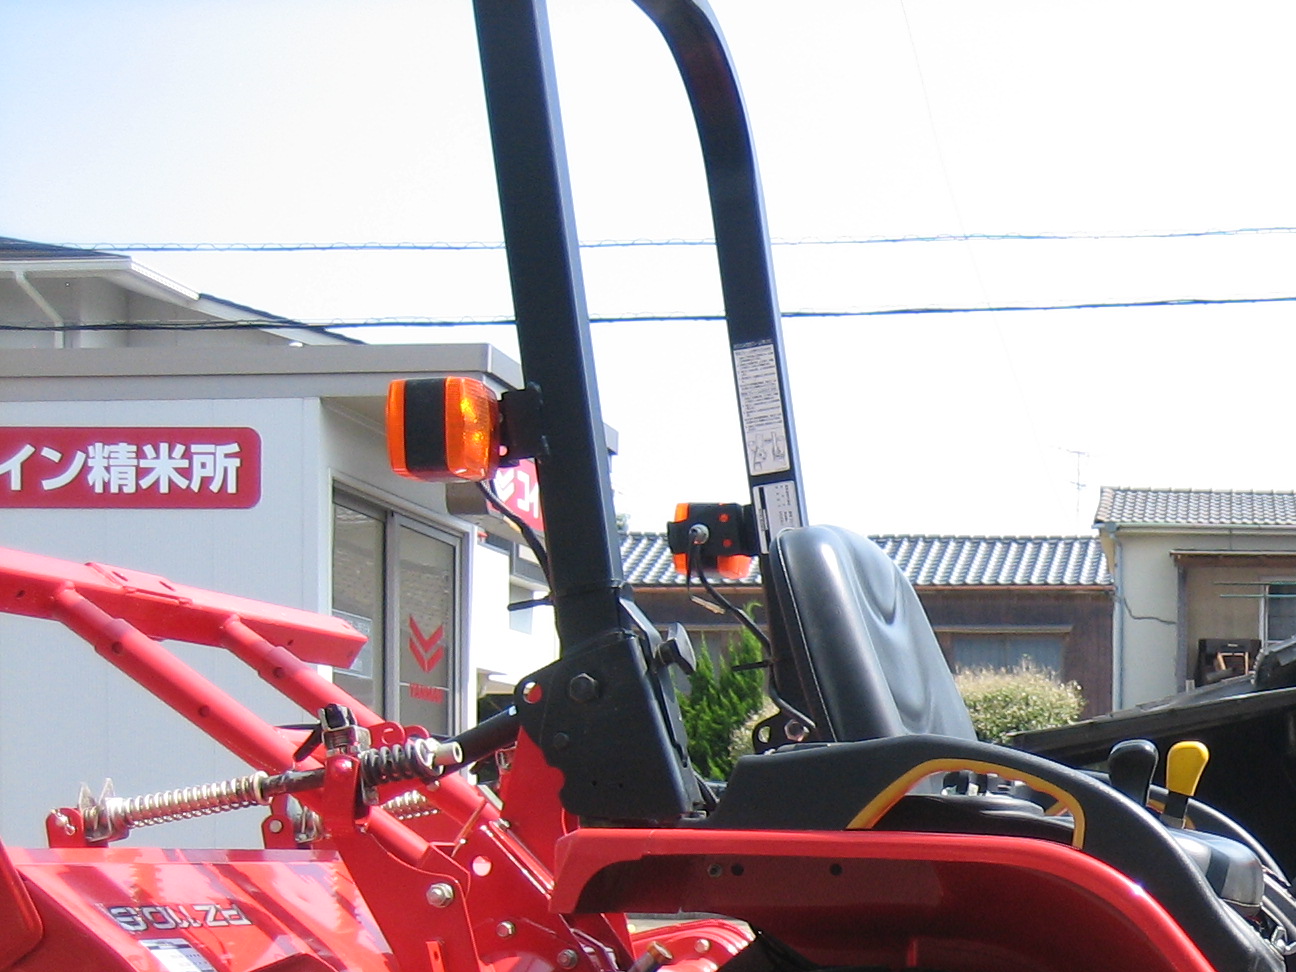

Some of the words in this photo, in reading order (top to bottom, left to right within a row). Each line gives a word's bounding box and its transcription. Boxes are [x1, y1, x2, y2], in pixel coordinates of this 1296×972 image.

[0, 442, 240, 494] イン精米所
